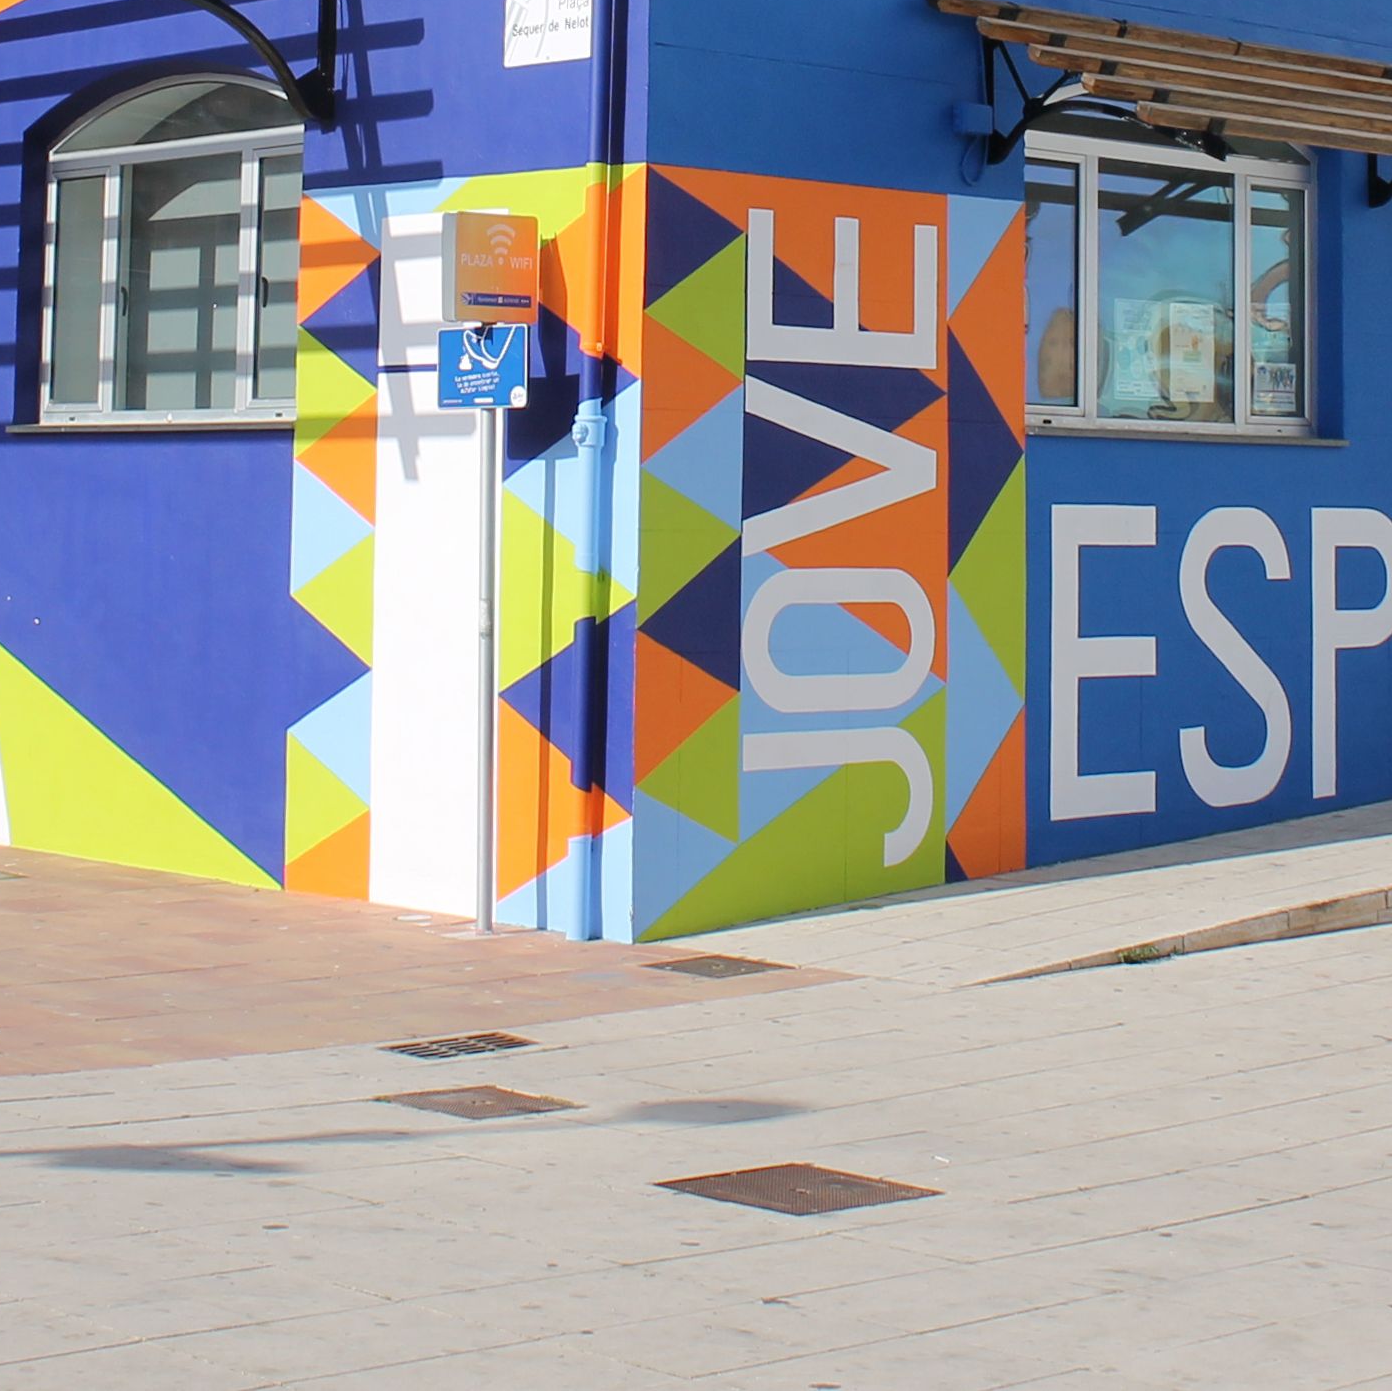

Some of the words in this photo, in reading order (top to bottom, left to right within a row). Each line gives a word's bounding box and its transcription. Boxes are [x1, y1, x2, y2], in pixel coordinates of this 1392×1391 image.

[512, 24, 543, 38] Sequer
[549, 20, 559, 31] de
[461, 253, 494, 268] PLAZA
[509, 256, 533, 270] WIFI
[742, 208, 938, 868] JOVE
